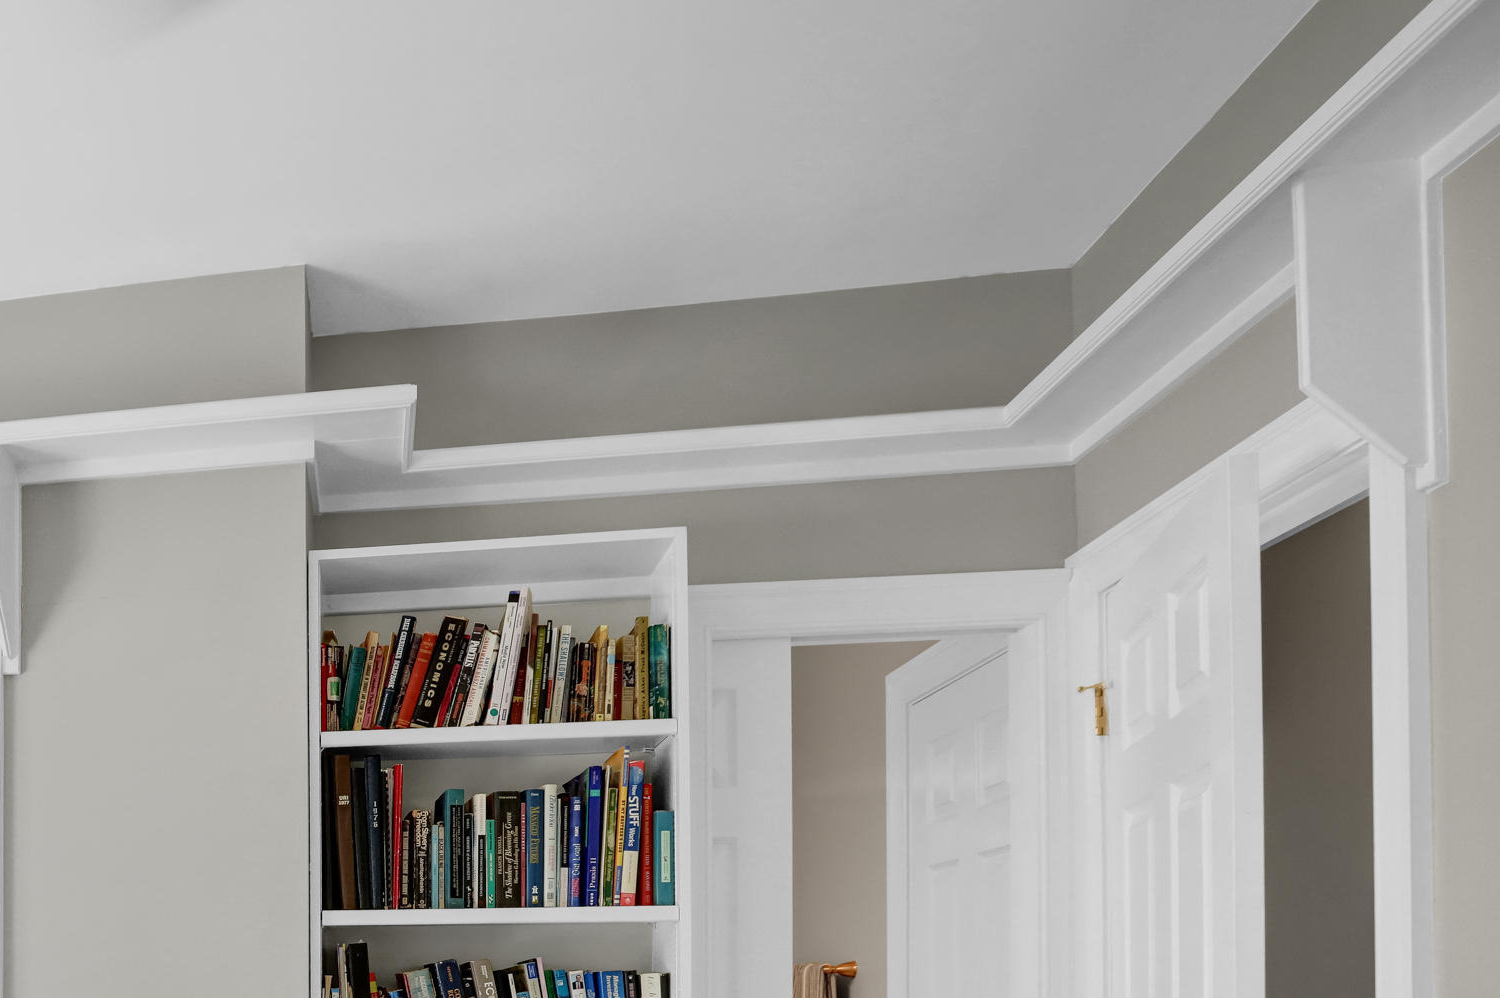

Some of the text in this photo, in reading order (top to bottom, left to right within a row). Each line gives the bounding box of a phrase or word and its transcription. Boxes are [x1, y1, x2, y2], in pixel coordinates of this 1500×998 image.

[424, 623, 456, 708] ECONOMICS
[557, 633, 570, 681] THE SHALLOWS
[628, 796, 640, 827] STUFF
[415, 819, 423, 847] Freedom
[421, 827, 429, 850] Slavery
[505, 830, 514, 856] Blooming
[628, 828, 636, 847] Works
